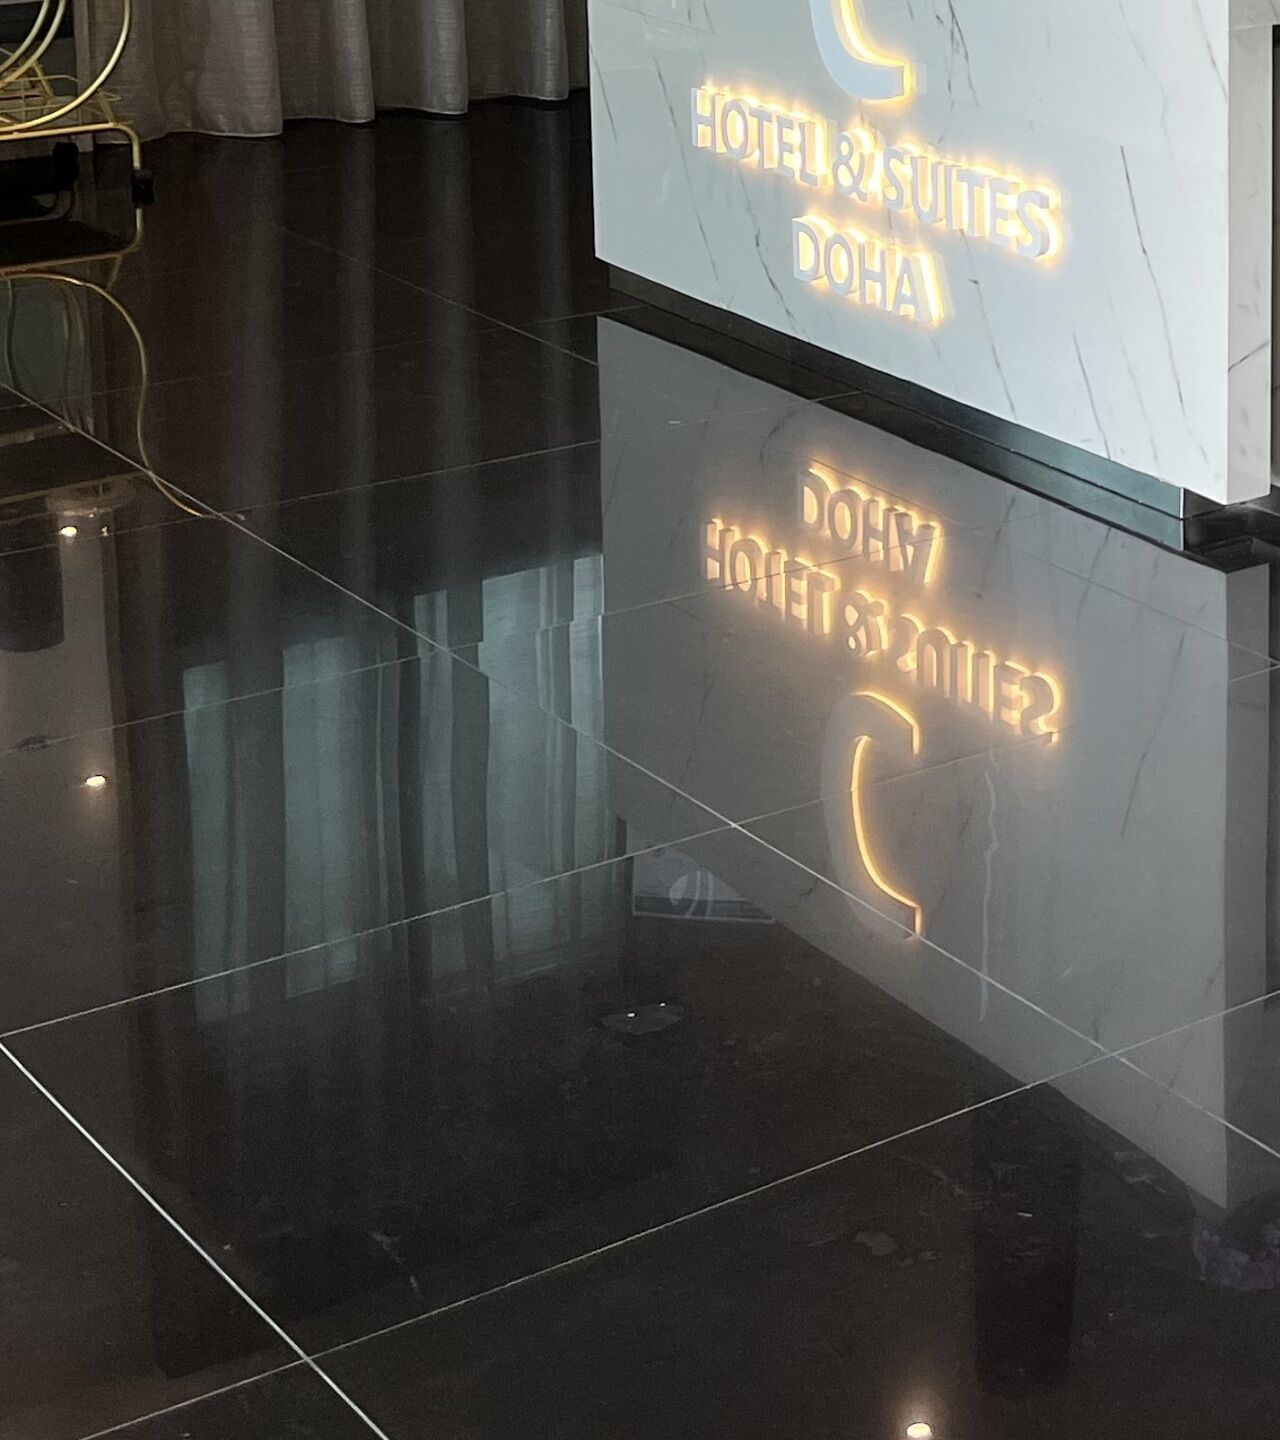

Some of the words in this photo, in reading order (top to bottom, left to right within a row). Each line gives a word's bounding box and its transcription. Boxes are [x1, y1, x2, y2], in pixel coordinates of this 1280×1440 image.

[690, 85, 832, 188] HOTEL
[831, 128, 878, 203] &
[882, 142, 1062, 259] SUITES
[791, 212, 945, 326] DOHA
